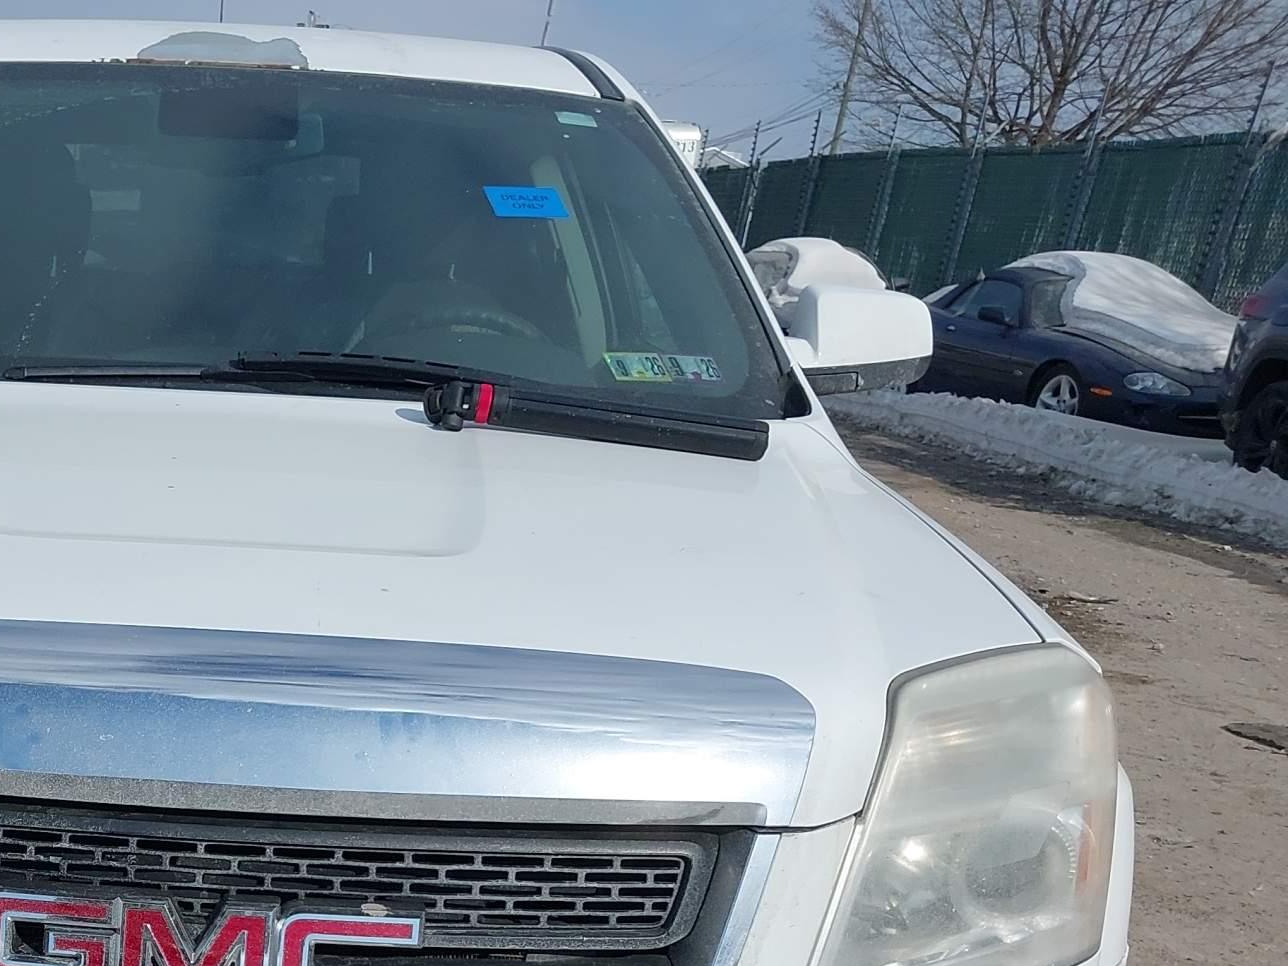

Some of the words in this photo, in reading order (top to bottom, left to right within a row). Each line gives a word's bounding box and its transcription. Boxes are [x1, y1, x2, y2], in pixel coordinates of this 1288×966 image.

[500, 193, 550, 202] DEALER
[616, 359, 629, 377] 9
[644, 356, 666, 376] 26
[700, 358, 721, 378] 26
